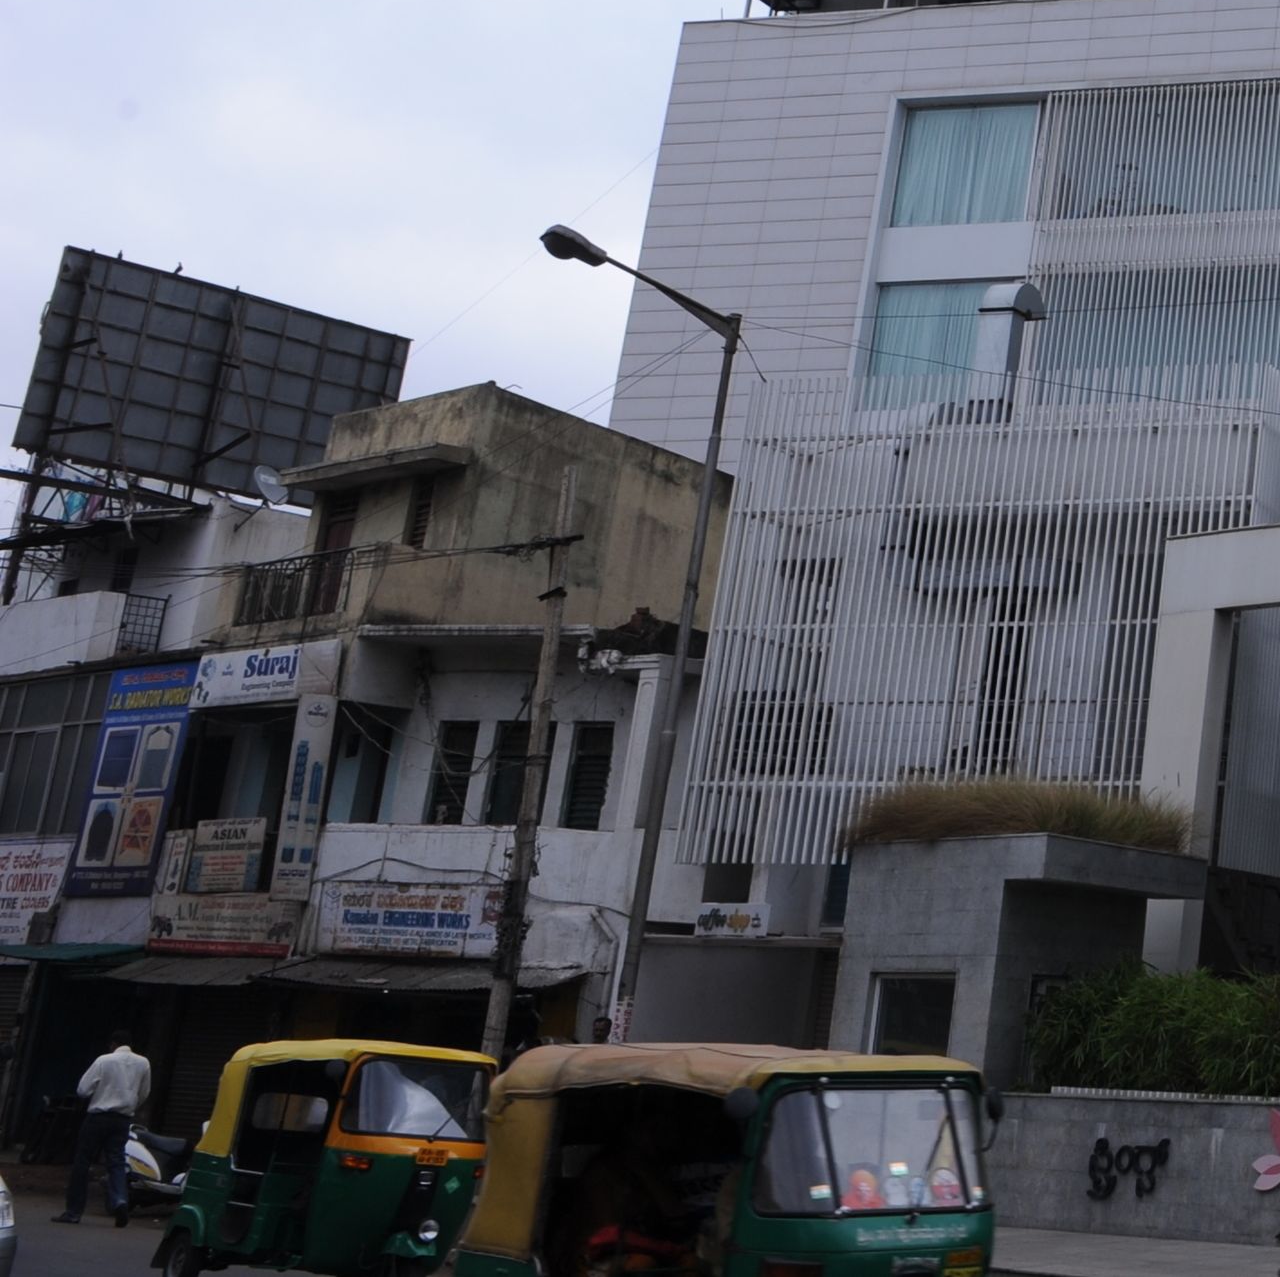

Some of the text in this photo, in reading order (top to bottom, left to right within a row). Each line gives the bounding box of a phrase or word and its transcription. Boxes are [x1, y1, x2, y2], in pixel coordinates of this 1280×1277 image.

[244, 649, 299, 679] Suraj
[211, 828, 247, 841] ASIAN
[6, 872, 53, 892] COMPANY
[383, 910, 435, 928] ENGINEERING
[437, 913, 471, 930] WORKS
[698, 908, 727, 931] coffee
